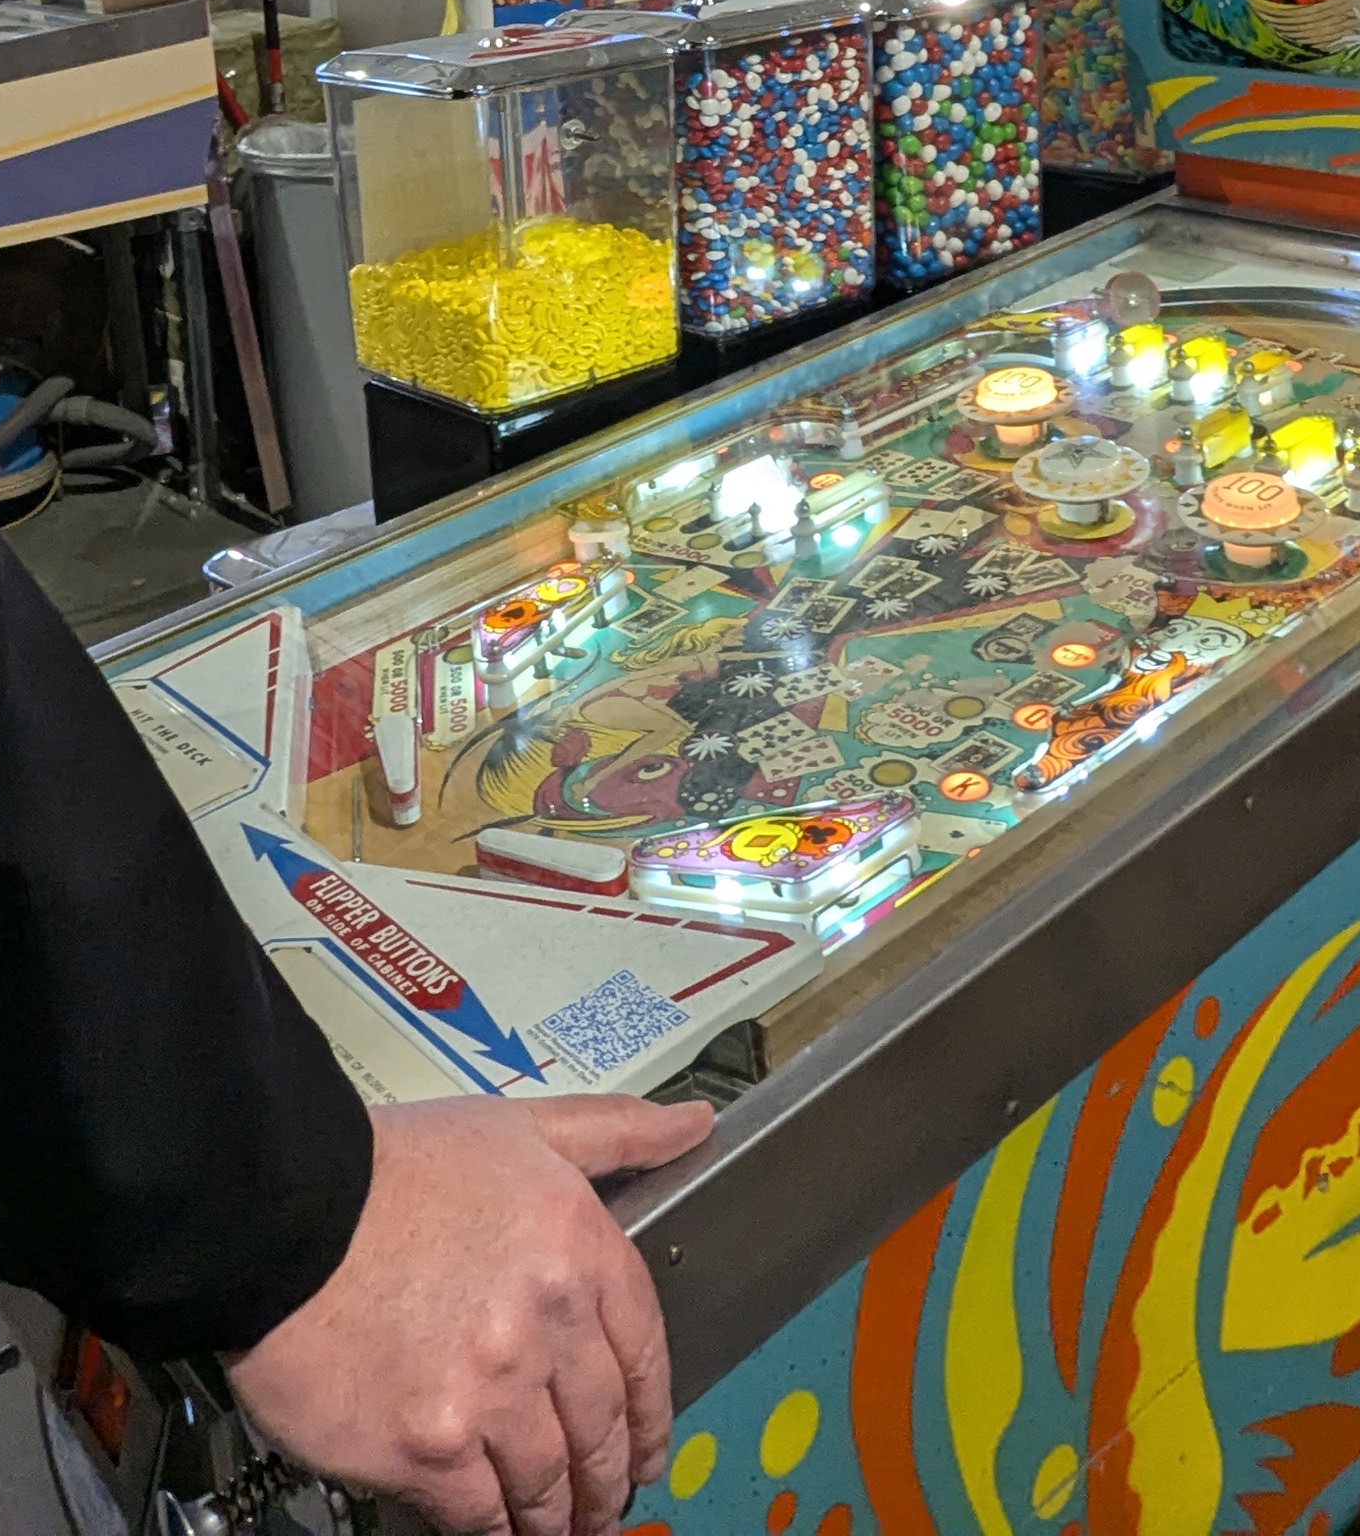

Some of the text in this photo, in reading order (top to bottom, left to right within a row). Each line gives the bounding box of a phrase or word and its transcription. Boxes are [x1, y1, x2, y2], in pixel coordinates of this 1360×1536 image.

[1222, 475, 1285, 502] 100
[390, 679, 408, 713] 5000
[450, 698, 467, 733] 5000
[887, 707, 943, 737] 5000
[130, 709, 154, 724] HIT
[152, 724, 178, 742] THE
[177, 742, 213, 767] DECK
[947, 777, 981, 798] K
[306, 898, 420, 997] ON SIDE OF CABINET
[309, 875, 459, 995] FLIPPER BUTTONS
